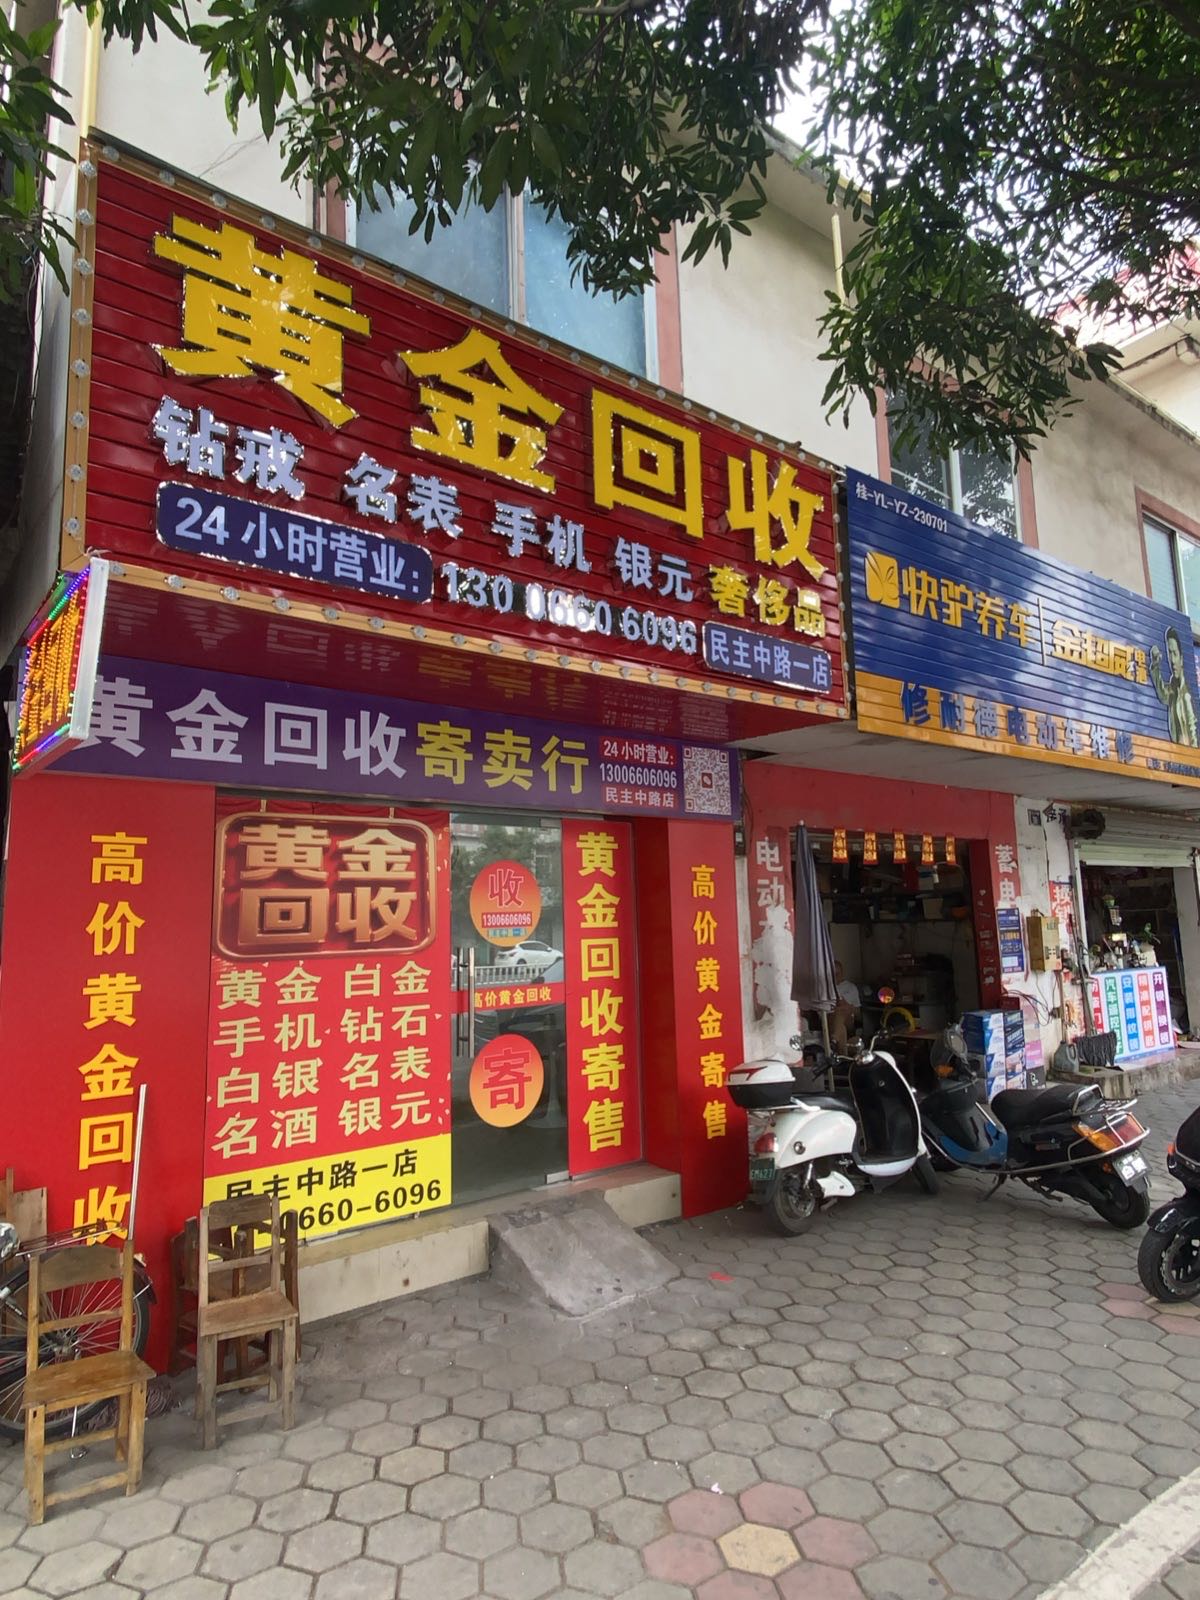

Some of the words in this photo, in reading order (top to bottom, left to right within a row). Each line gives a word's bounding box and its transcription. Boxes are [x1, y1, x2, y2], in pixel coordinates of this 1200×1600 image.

[150, 214, 828, 581] 黄金回收
[151, 395, 305, 500] 钻戒
[343, 451, 463, 538] 名表
[491, 500, 591, 574] 手机
[614, 537, 693, 603] 银元
[710, 563, 826, 638] 奢侈品
[855, 482, 948, 533] 桂-YL-YZ-230701
[440, 561, 513, 614] 130
[620, 605, 698, 655] 6096
[902, 565, 1034, 648] 快驴养车
[709, 629, 828, 688] 民主中路一店
[599, 762, 678, 789] 13006606096
[605, 786, 674, 808] 民主中路店
[238, 824, 418, 882] 黄金
[239, 886, 418, 946] 回收
[488, 868, 525, 909] 收
[483, 912, 532, 928] 13006606096
[216, 965, 322, 1010] 黄金
[344, 960, 432, 999] 白金
[474, 986, 552, 1009] 高价黄金回收
[576, 832, 625, 1152] 黄金回收寄售
[690, 864, 727, 1140] 高价黄金寄售
[72, 831, 148, 1247] 高价黄金回收
[213, 1013, 322, 1059] 手机
[340, 1003, 432, 1044] 钻石
[216, 1059, 322, 1108] 白银
[340, 1046, 432, 1091] 名表
[483, 1047, 532, 1110] 寄
[210, 1106, 318, 1159] 名酒
[338, 1090, 432, 1138] 银元
[226, 1149, 418, 1201] 民主中路一店
